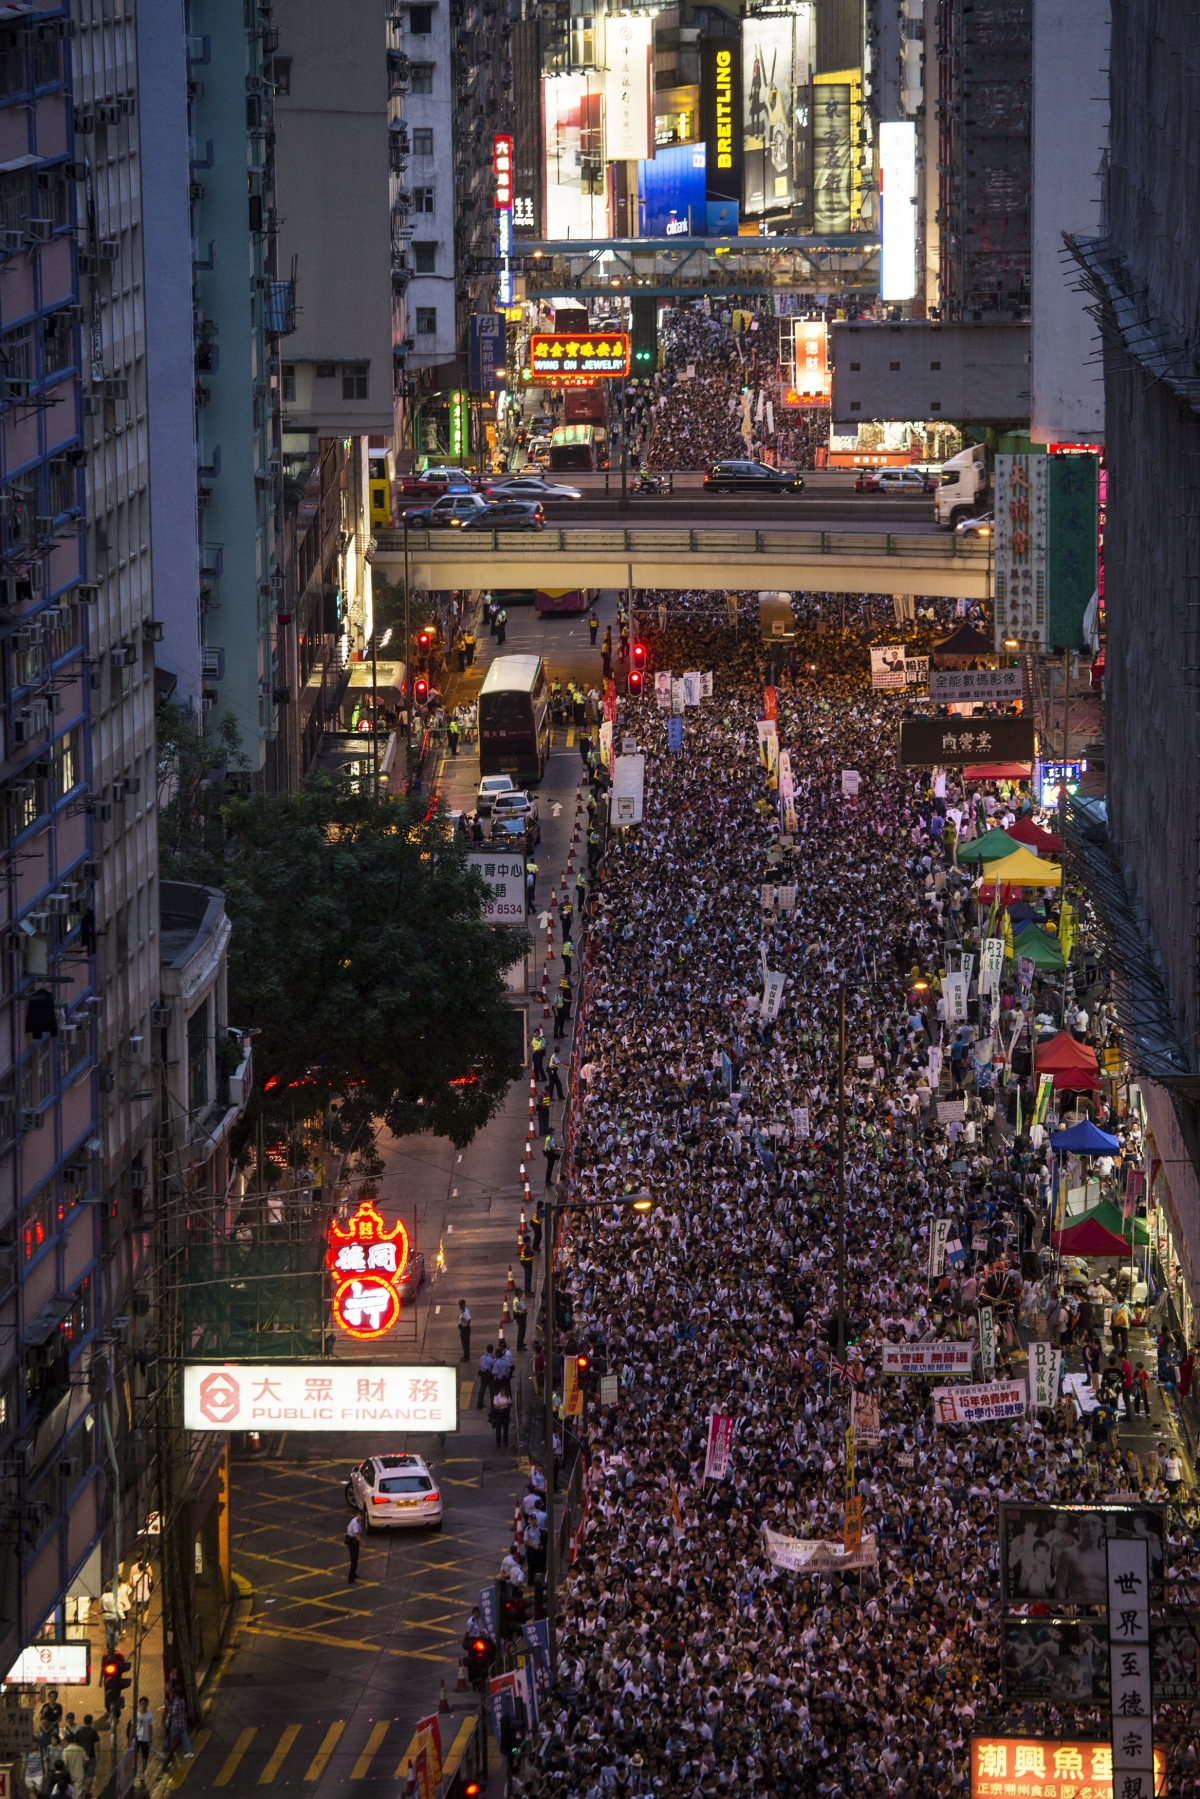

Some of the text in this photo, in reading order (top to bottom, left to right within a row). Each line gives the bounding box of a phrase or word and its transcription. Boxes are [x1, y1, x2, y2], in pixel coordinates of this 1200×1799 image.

[716, 50, 732, 169] BREITLING
[666, 218, 688, 236] citibank
[482, 339, 494, 388] 富邦銀行
[533, 359, 626, 371] WING ON JEWELRY
[936, 672, 1016, 688] 全能數碼影像
[497, 904, 522, 915] 8534
[344, 1281, 391, 1330] 押
[886, 1352, 968, 1364] 真普選 無篩選
[901, 1363, 953, 1371] 廢除功能組別
[958, 1390, 1020, 1408] 15年免費教育
[252, 1408, 442, 1420] PUBLIC FINANCE
[964, 1403, 1025, 1421] 中學小班教學
[977, 1783, 1056, 1798] 正宗潮州食品
